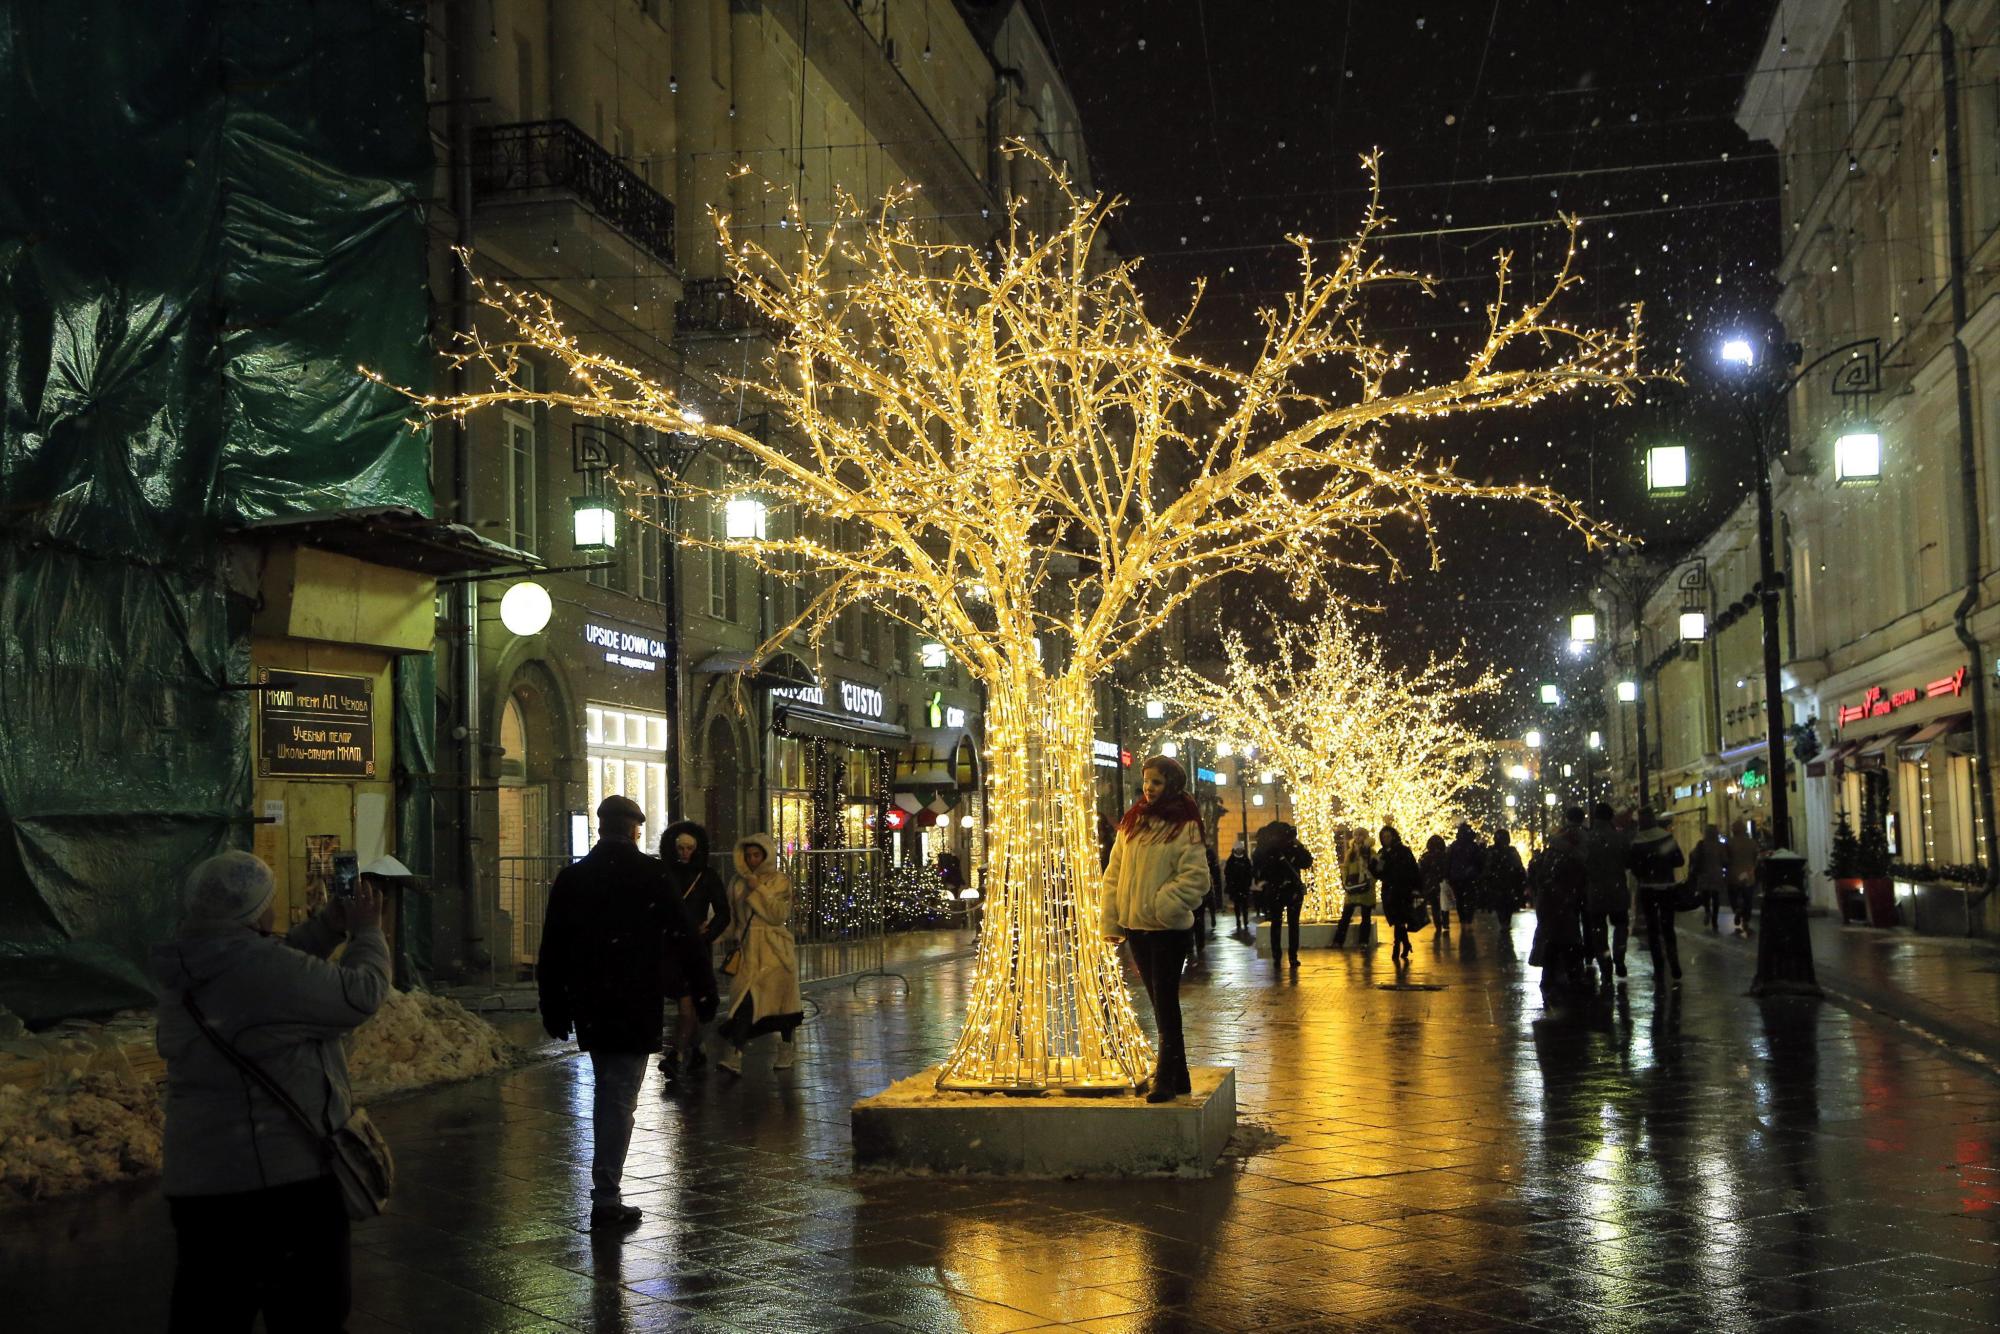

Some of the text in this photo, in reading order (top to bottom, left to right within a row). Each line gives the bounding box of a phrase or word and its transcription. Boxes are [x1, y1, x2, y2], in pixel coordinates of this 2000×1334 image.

[586, 624, 620, 650] UPSIDE
[621, 633, 649, 656] DOWN
[266, 689, 294, 707] МХАТ
[337, 745, 362, 762] МХАТ
